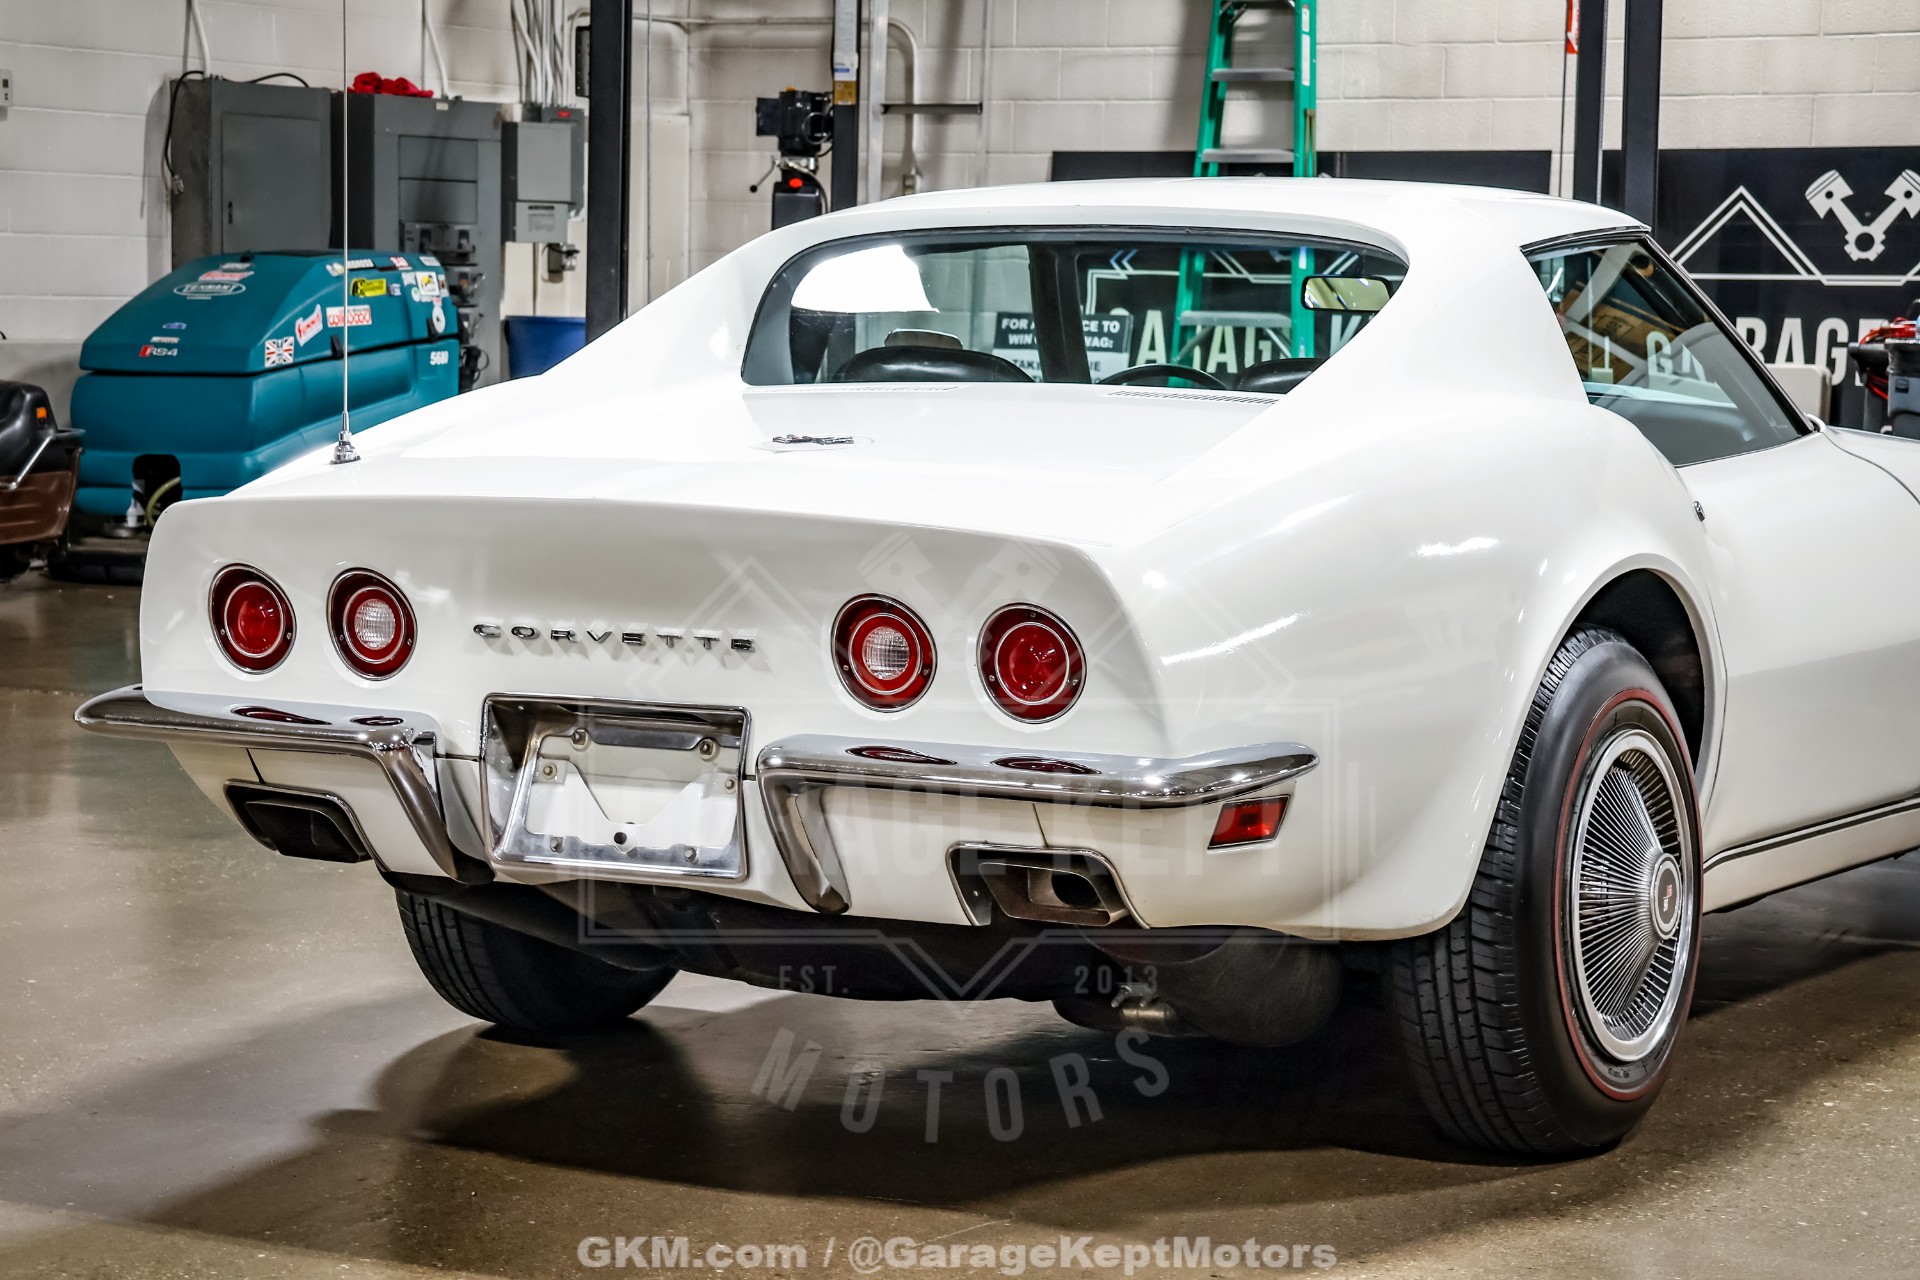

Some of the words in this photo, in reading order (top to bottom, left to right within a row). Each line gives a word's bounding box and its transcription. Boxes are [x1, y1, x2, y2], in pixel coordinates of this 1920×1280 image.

[1001, 318, 1028, 330] FOR
[1102, 320, 1120, 333] TO
[1008, 333, 1033, 345] WIN
[473, 623, 756, 652] CORVETTE
